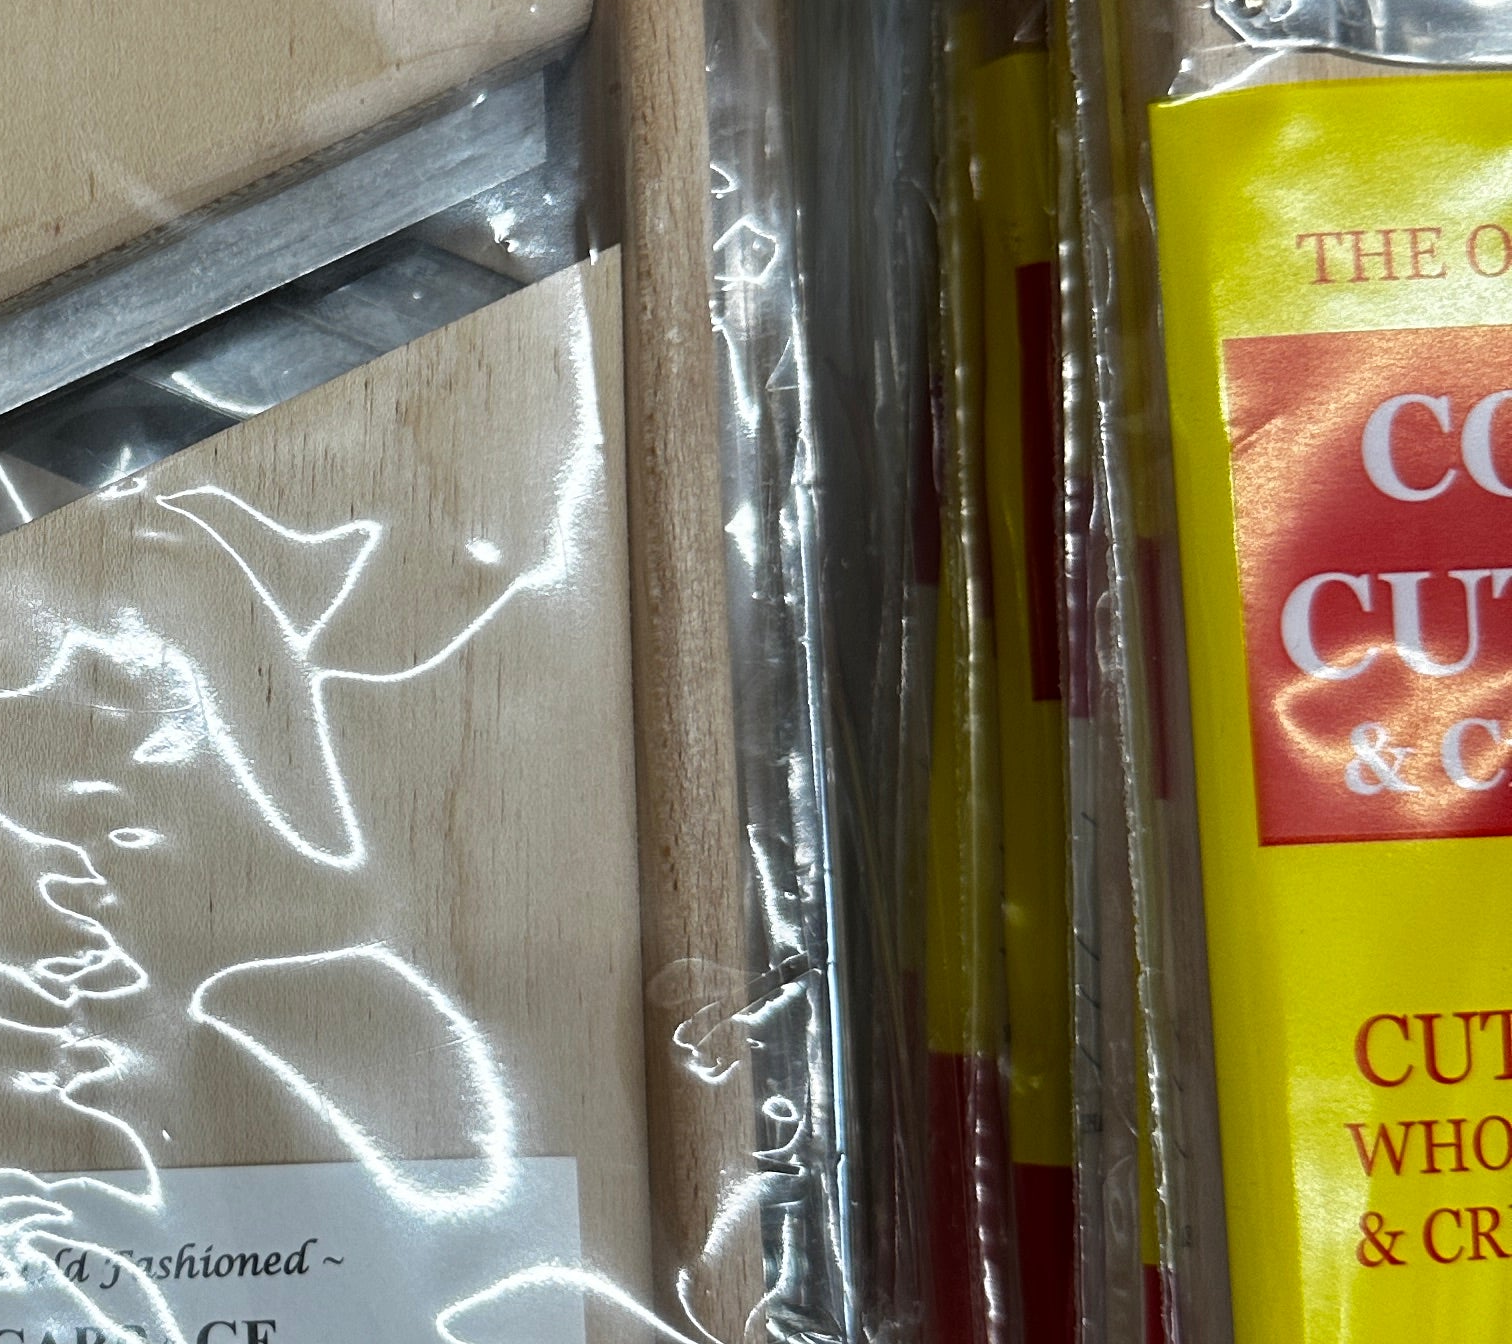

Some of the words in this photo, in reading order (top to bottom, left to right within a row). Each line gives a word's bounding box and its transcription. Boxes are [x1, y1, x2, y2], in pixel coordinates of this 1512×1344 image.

[1295, 227, 1447, 285] THE
[1344, 721, 1422, 796] &
[1440, 717, 1512, 792] C
[1344, 1115, 1512, 1177] WHO
[1356, 1211, 1407, 1268] &
[1423, 1204, 1512, 1265] CR
